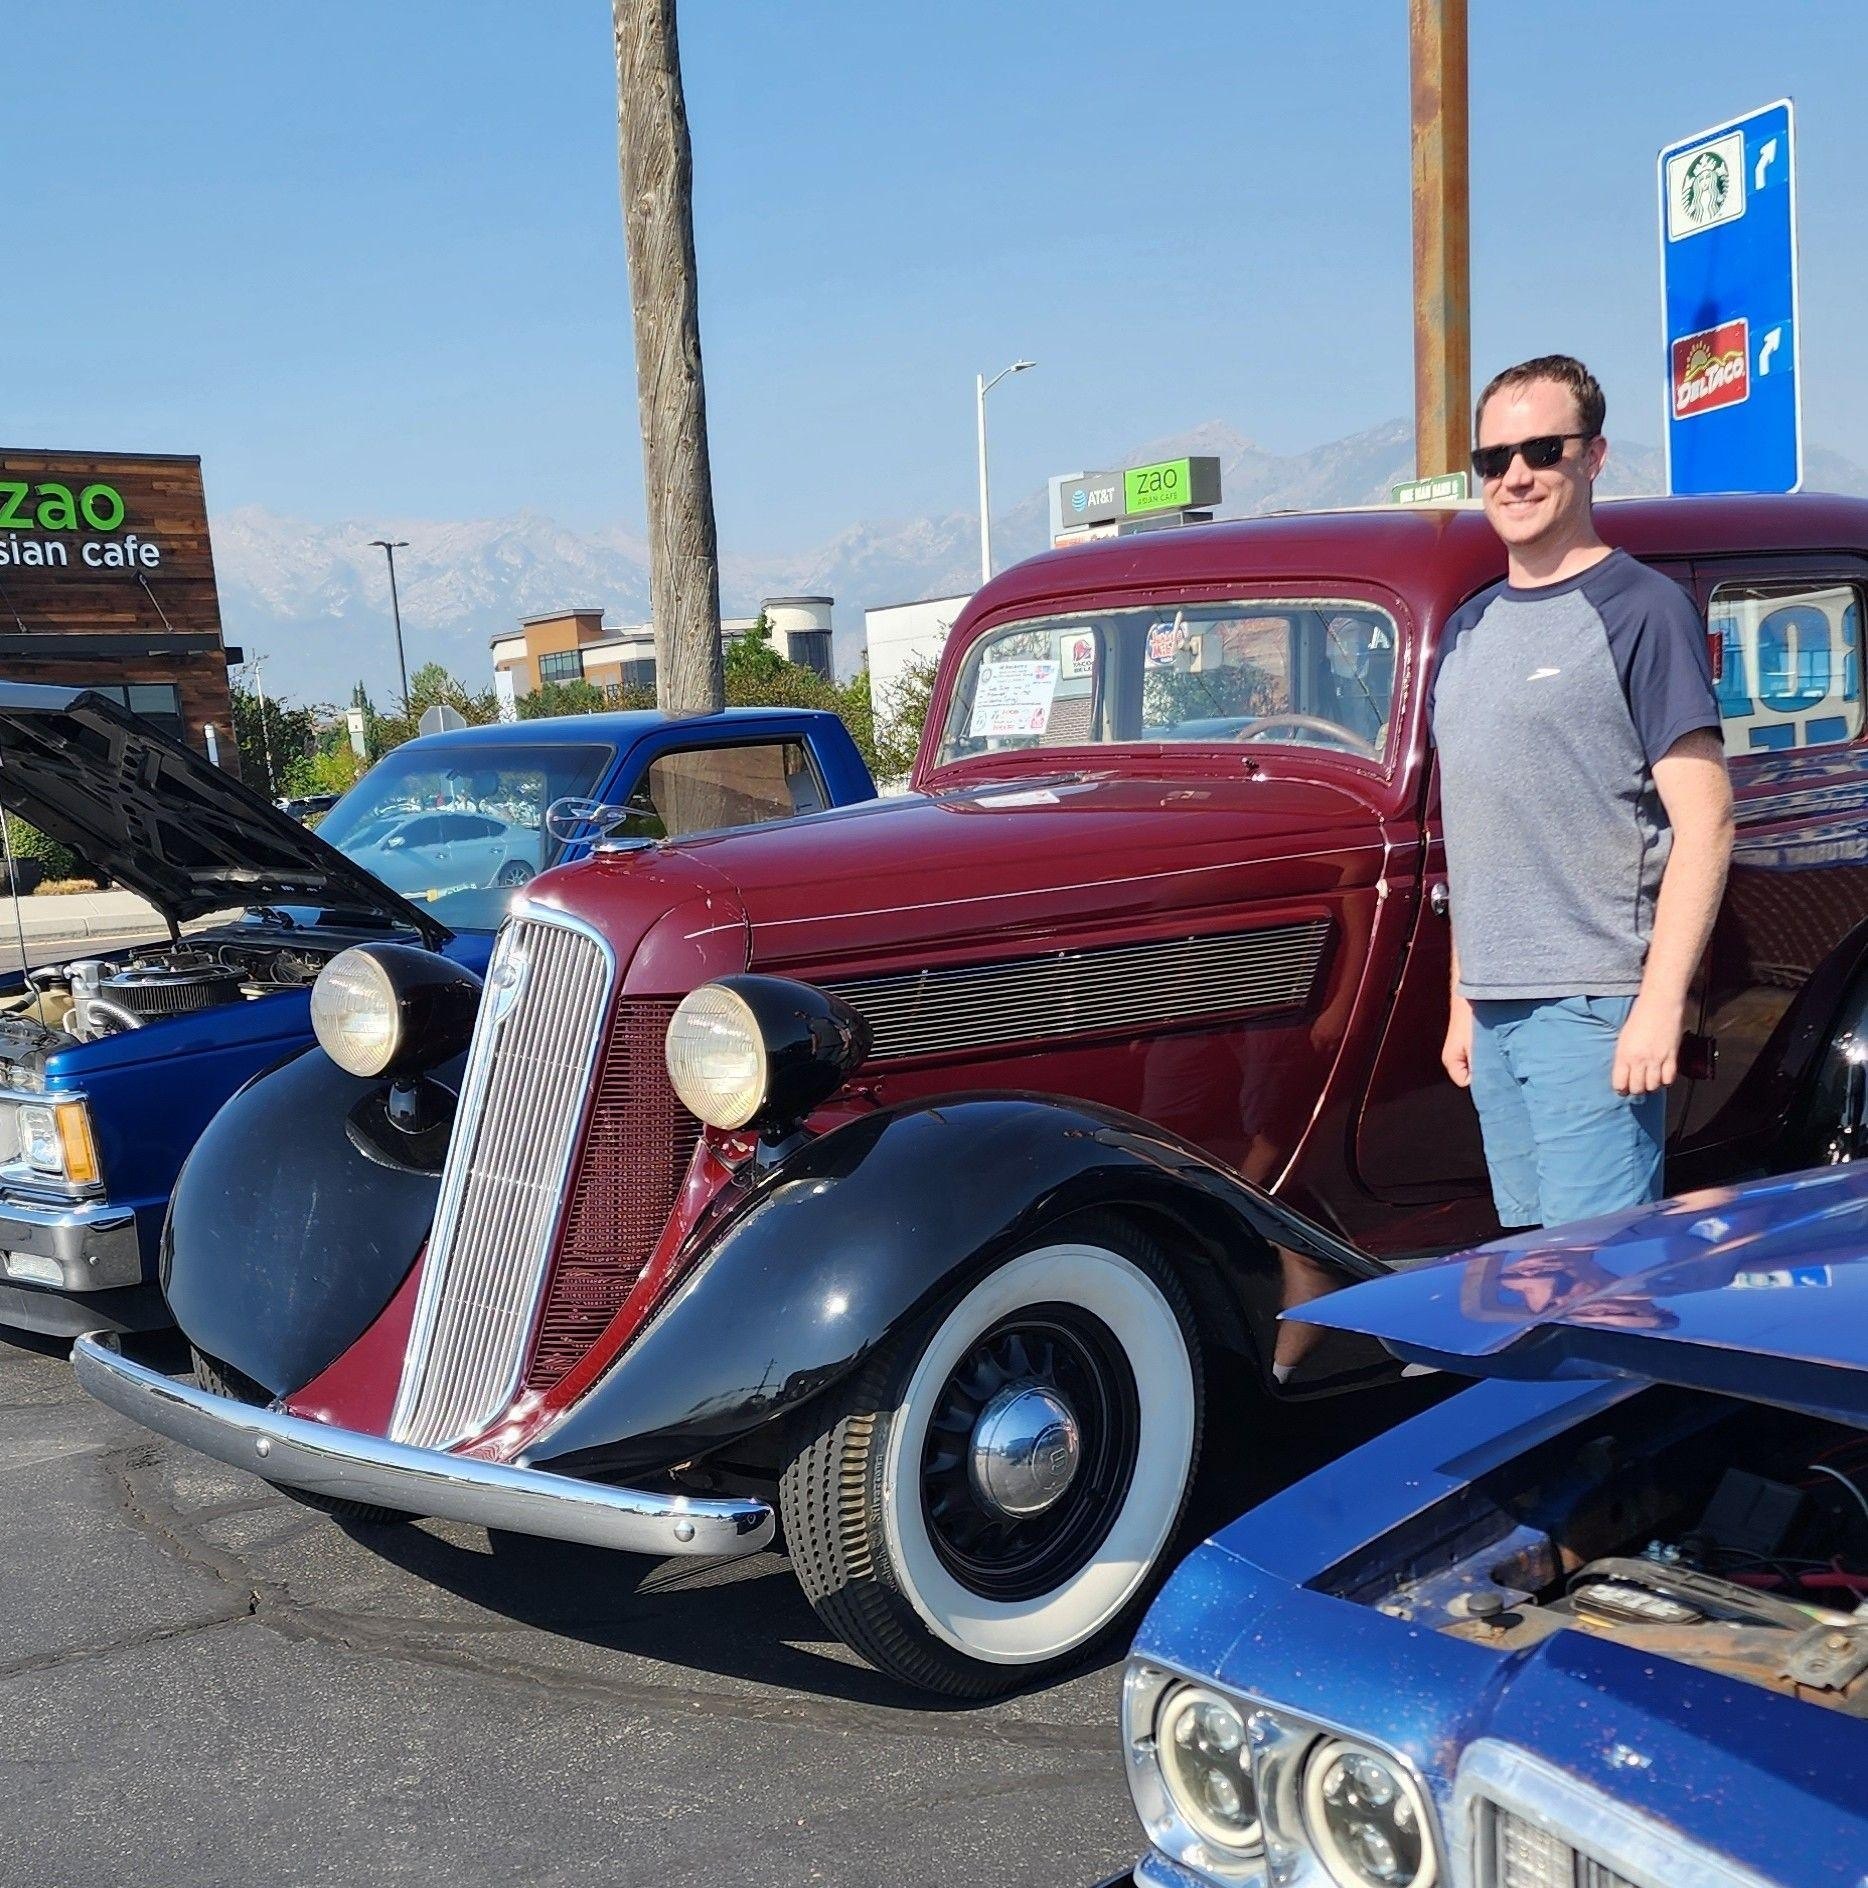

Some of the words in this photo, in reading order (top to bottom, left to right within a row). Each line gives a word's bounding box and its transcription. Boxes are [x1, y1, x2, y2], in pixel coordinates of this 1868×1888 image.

[1087, 486, 1115, 507] AT&T
[1137, 469, 1178, 495] zao
[0, 482, 125, 531] zao
[82, 534, 160, 567] cafe
